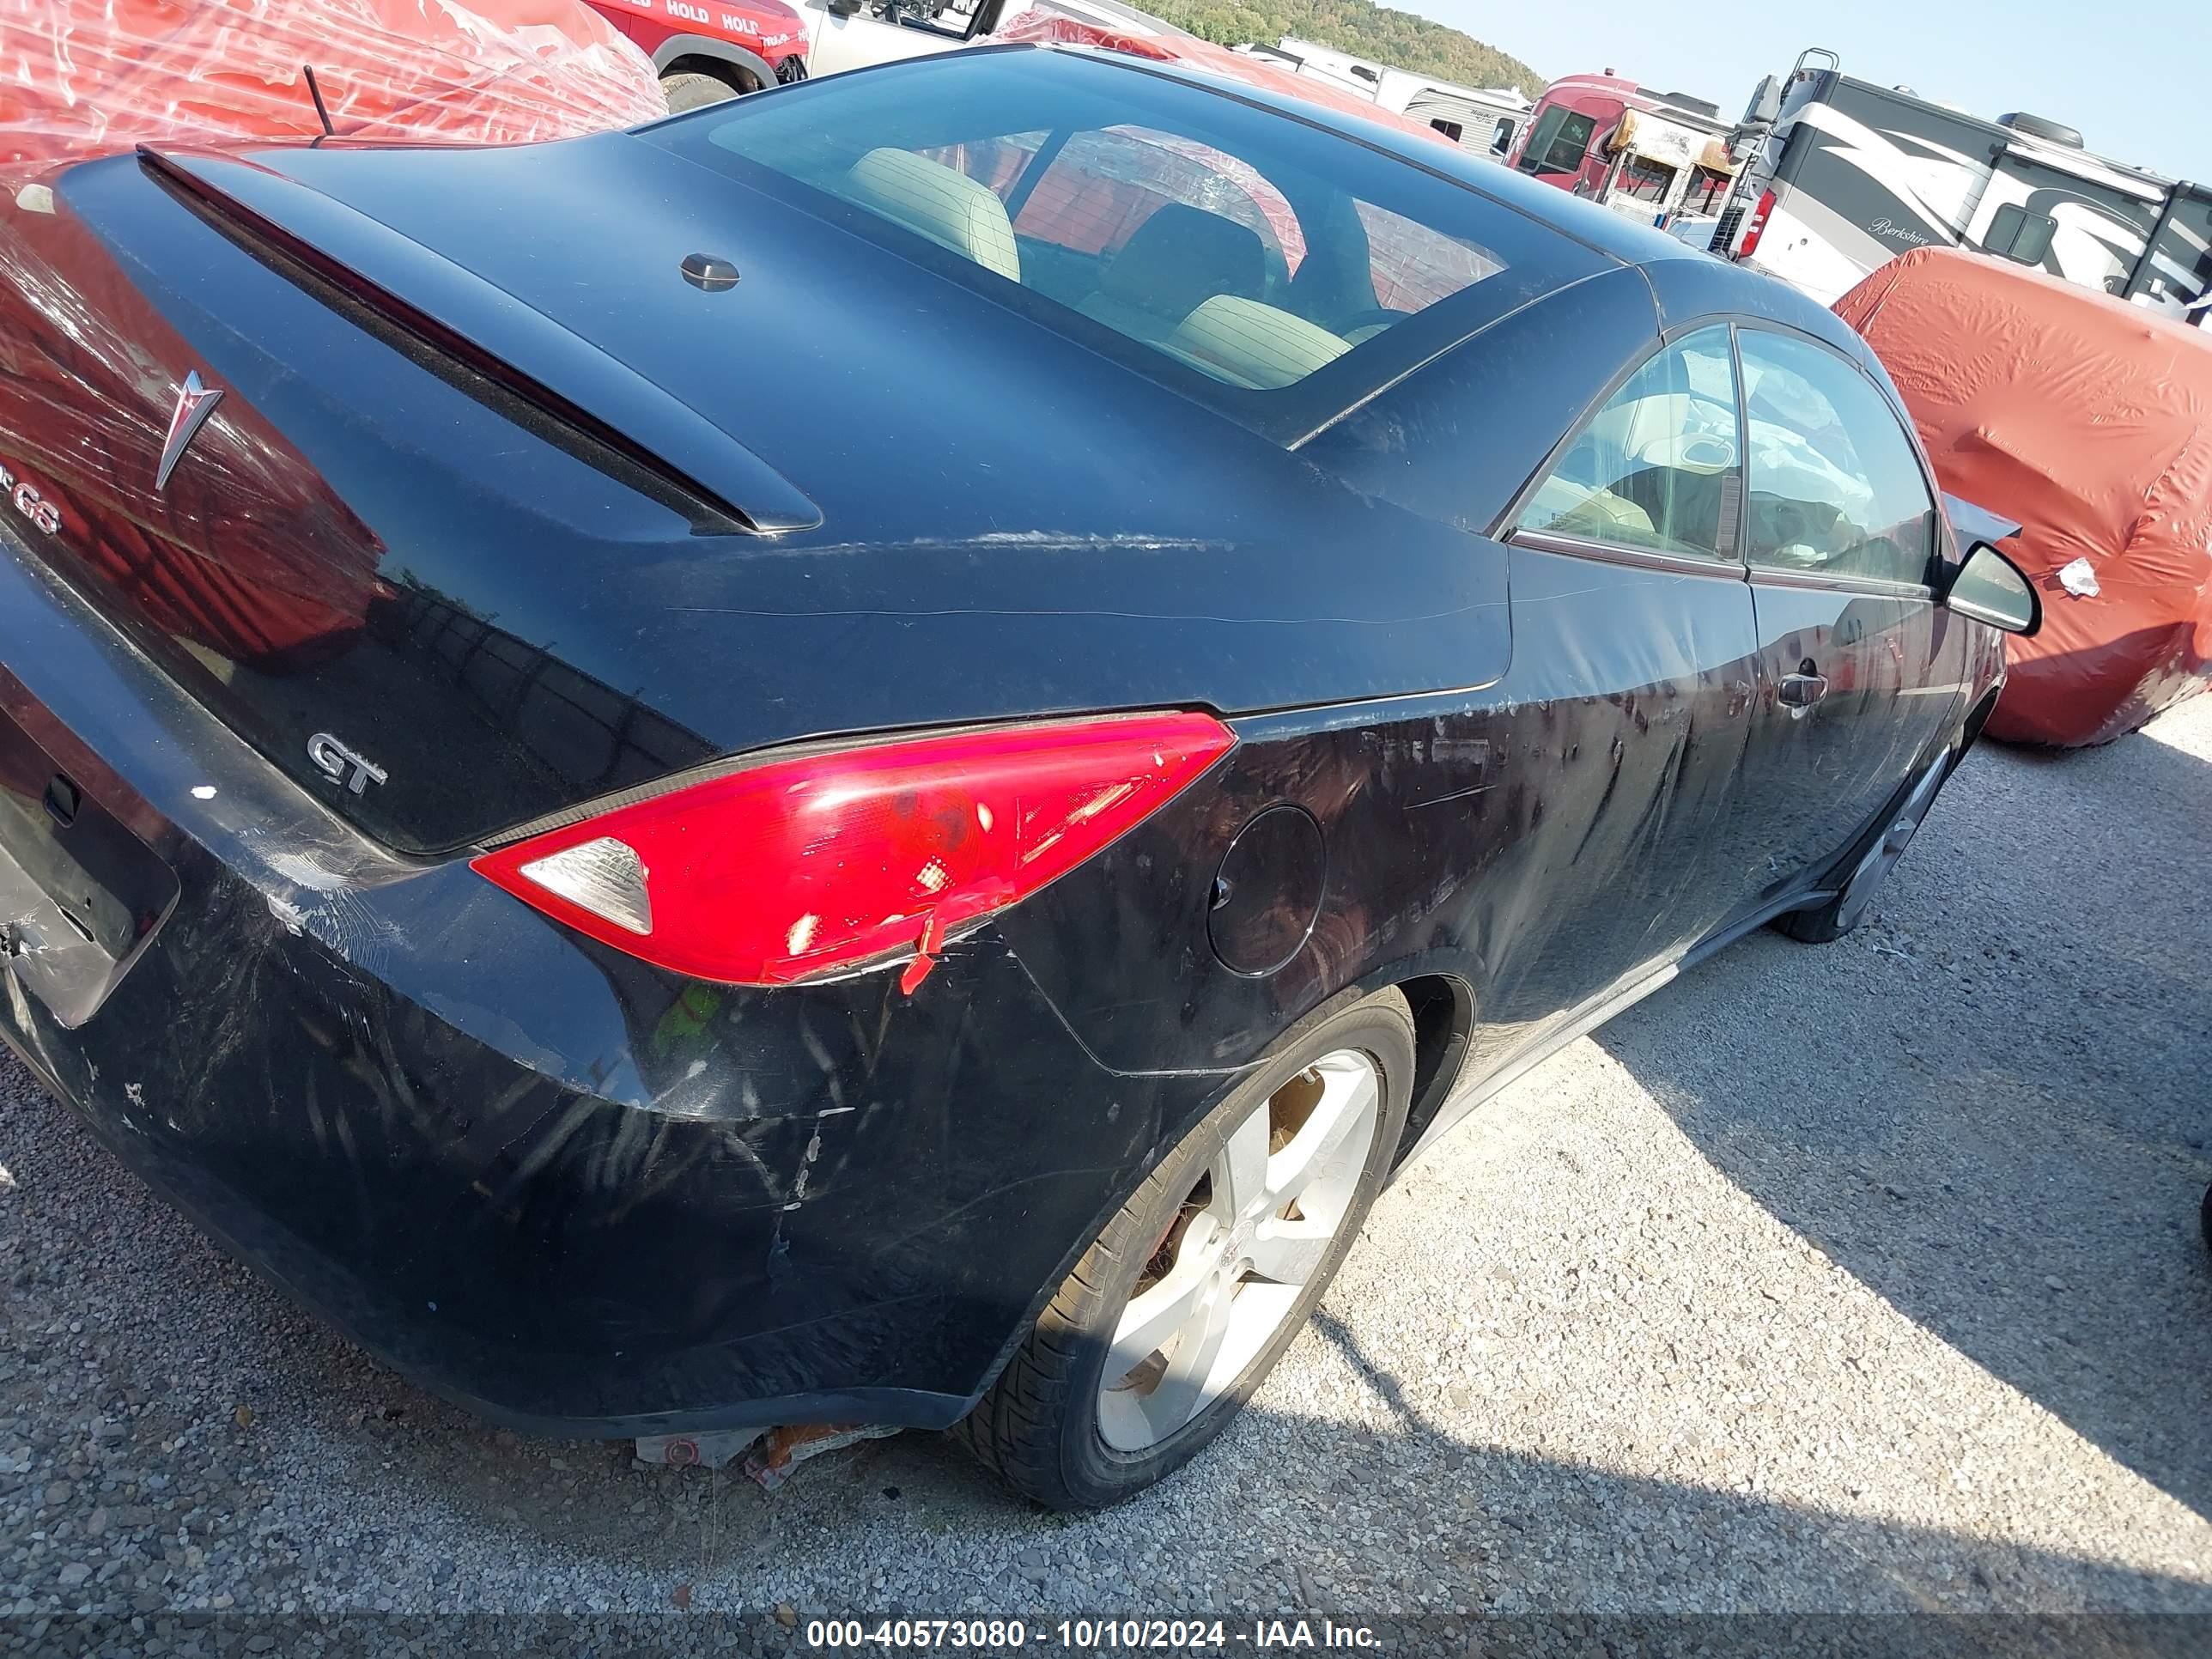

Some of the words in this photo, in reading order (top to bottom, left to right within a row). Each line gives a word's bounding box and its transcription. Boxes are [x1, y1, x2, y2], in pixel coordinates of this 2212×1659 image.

[665, 0, 710, 23] HOLD
[1868, 217, 1929, 246] Berkshire
[14, 483, 60, 534] G6
[307, 733, 388, 794] GT
